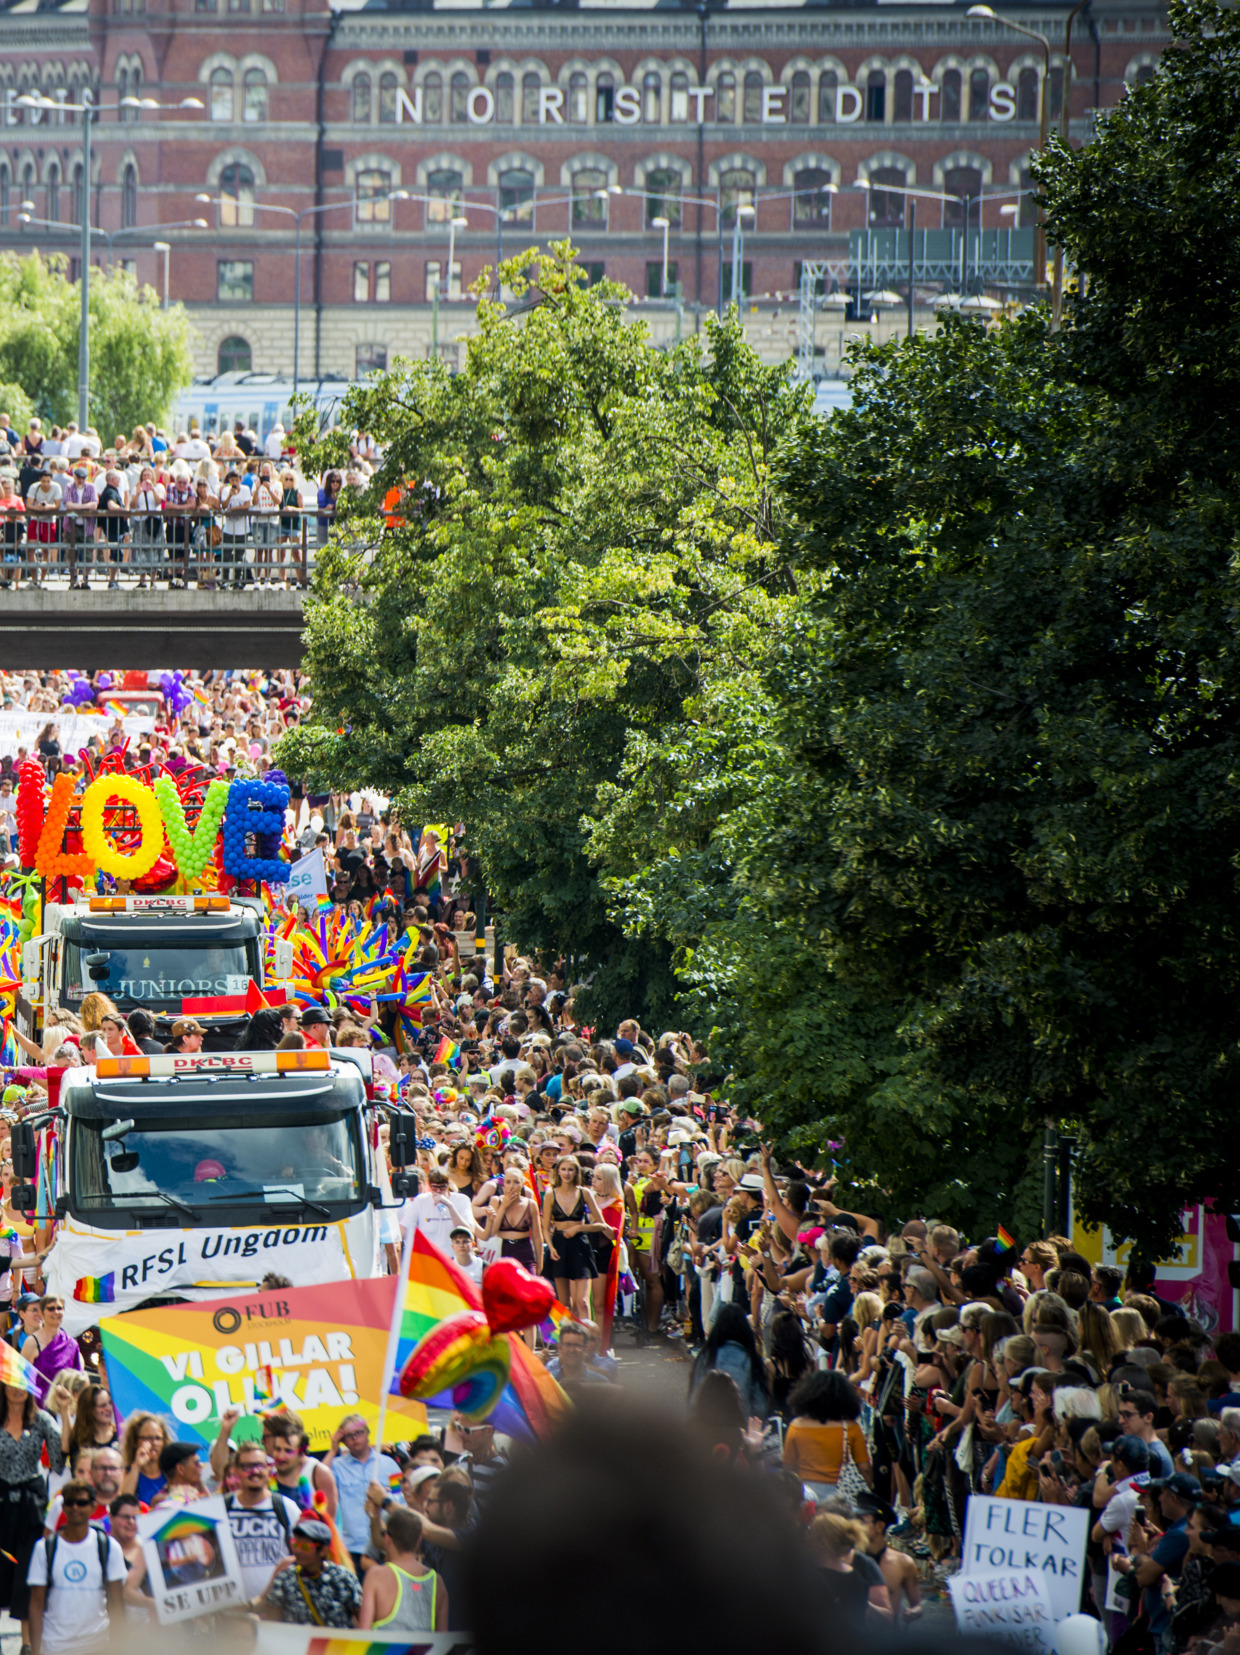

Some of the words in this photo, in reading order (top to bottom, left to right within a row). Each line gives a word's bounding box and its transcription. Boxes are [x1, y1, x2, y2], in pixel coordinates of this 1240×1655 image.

[395, 83, 1017, 126] NORSTEDTS
[34, 772, 292, 884] LOVE
[113, 979, 228, 998] JUNIORS
[174, 1057, 252, 1067] DKLBC
[122, 1242, 187, 1289] RFSL
[201, 1226, 328, 1259] Ungdom
[244, 1300, 291, 1321] FUB
[160, 1351, 204, 1382] VI
[215, 1331, 355, 1374] GILLAR
[986, 1504, 1069, 1545] FLER
[974, 1543, 1077, 1577] TOLKAR
[163, 1593, 191, 1614] SE
[196, 1581, 237, 1606] UPP
[963, 1575, 1039, 1603] QUEERA
